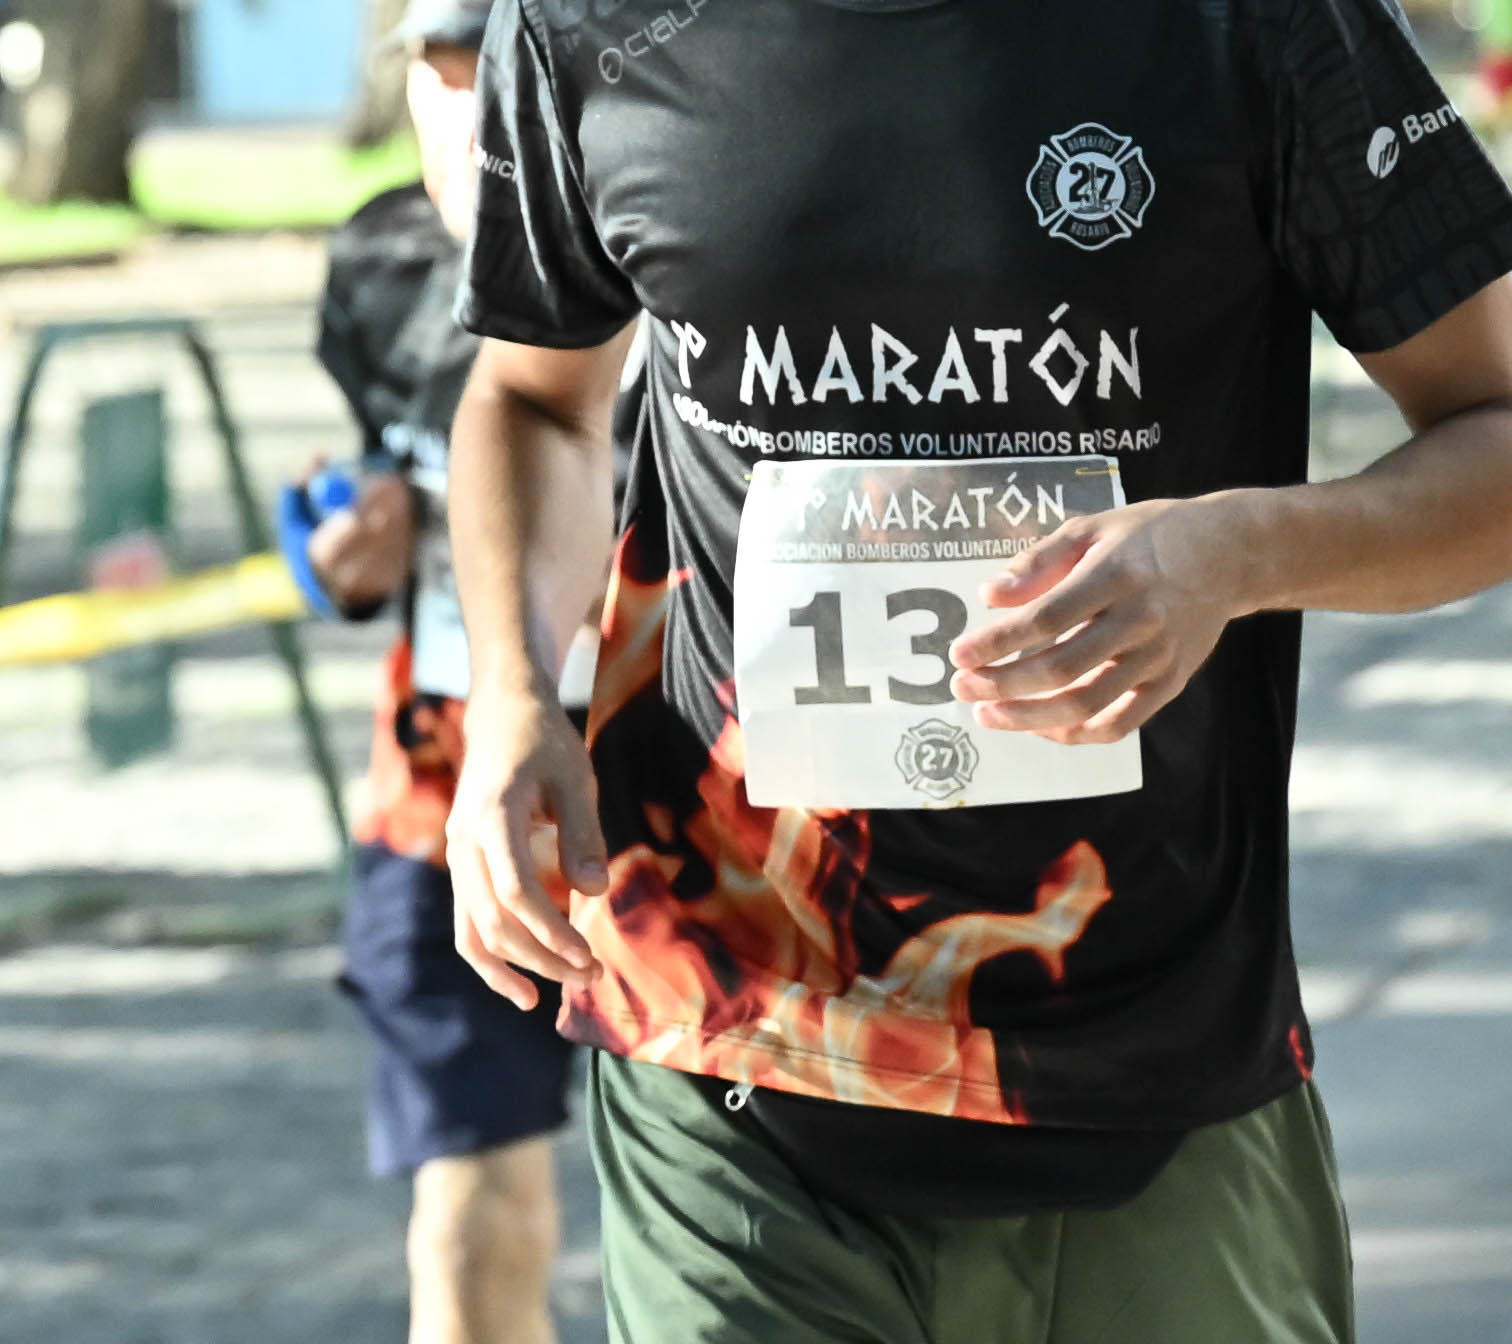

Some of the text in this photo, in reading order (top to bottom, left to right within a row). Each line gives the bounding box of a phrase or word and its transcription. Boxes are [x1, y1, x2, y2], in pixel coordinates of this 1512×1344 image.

[1069, 161, 1116, 203] 27
[739, 302, 1143, 406] MARATÓN
[760, 429, 893, 456] BOMBEROS
[899, 431, 1072, 457] VOLUNTARIOS
[841, 471, 1066, 532] MARATÓN
[846, 539, 931, 561] BOMBEROS
[933, 536, 1037, 559] VOLUNTARIOS
[789, 586, 974, 706] 13
